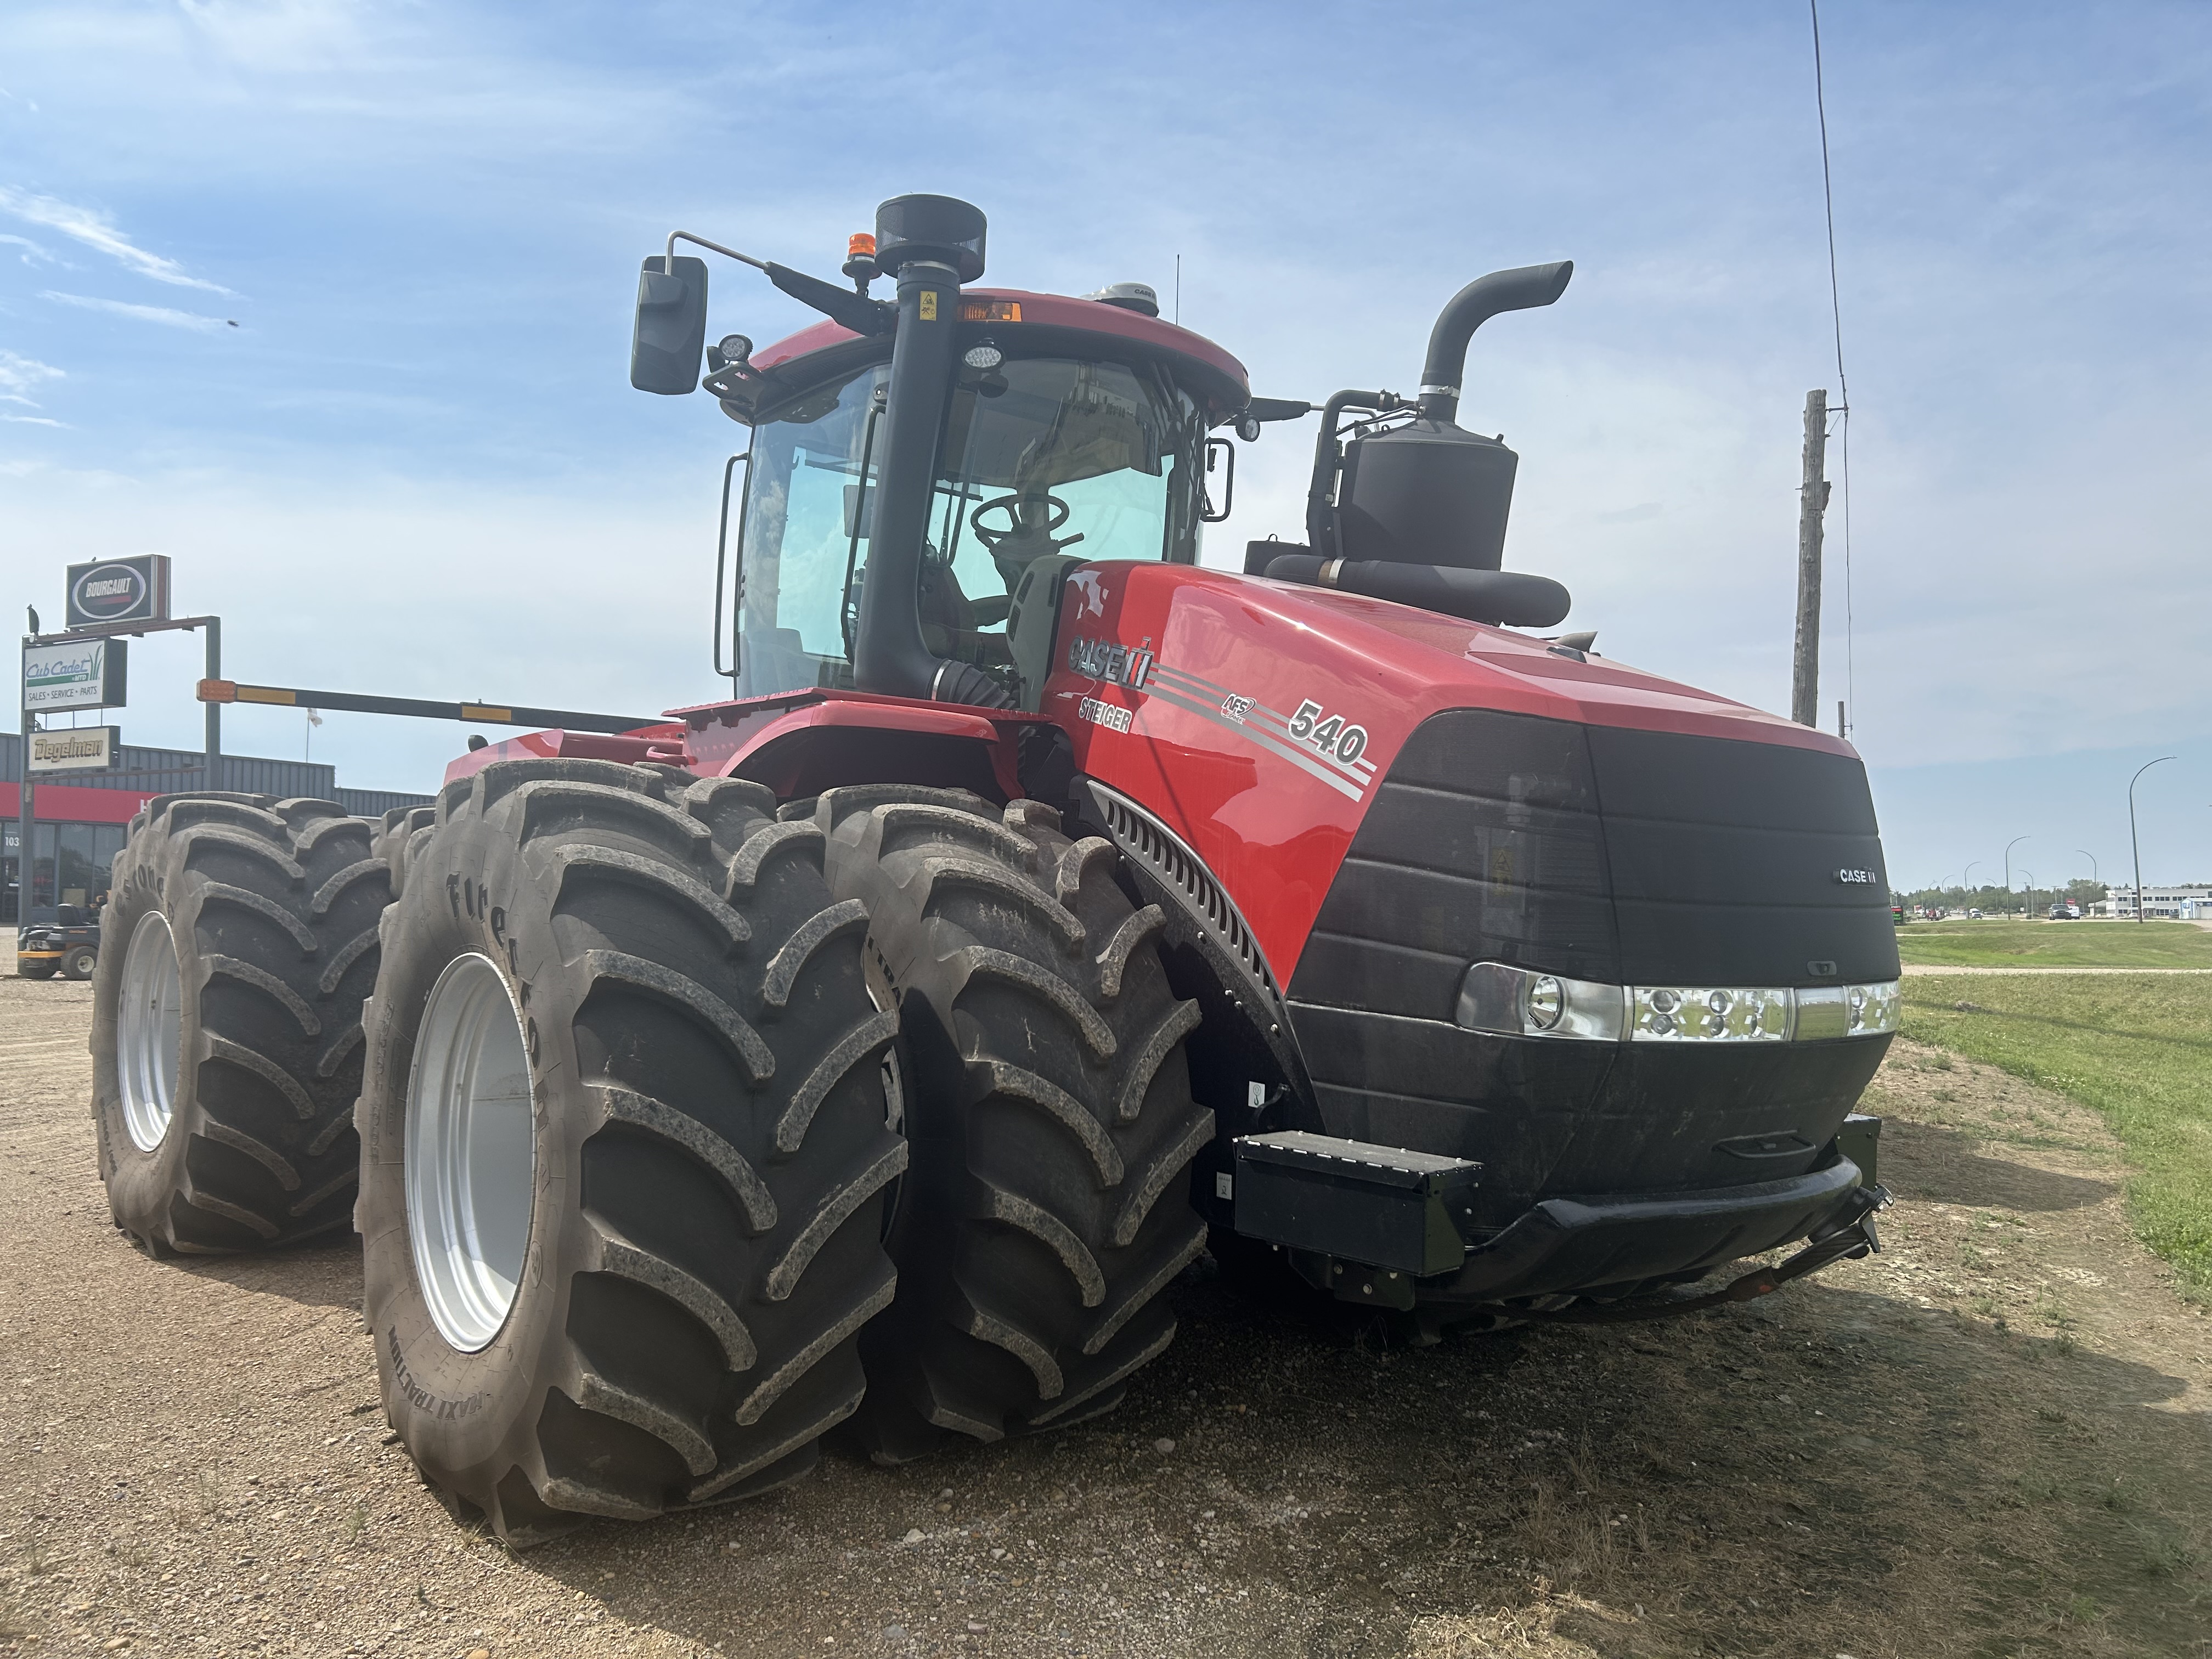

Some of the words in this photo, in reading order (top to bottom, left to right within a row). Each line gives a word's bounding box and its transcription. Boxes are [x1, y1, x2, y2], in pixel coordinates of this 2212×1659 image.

[1135, 289, 1152, 297] CASE
[86, 577, 132, 598] BOURGAULT
[26, 662, 50, 678] Cub
[50, 658, 91, 676] Cadet
[1068, 635, 1128, 684] CASE
[29, 692, 46, 702] SALES
[50, 689, 74, 699] SERVICE
[80, 685, 98, 696] PARTS
[1221, 693, 1250, 714] AFS
[1078, 696, 1133, 734] STEIGER
[1288, 698, 1368, 766] 540
[35, 736, 103, 763] Degelman
[5, 836, 20, 847] 103
[1839, 868, 1867, 883] CASE
[387, 1324, 437, 1415] TRACTION
[436, 1390, 483, 1420] MAXI
